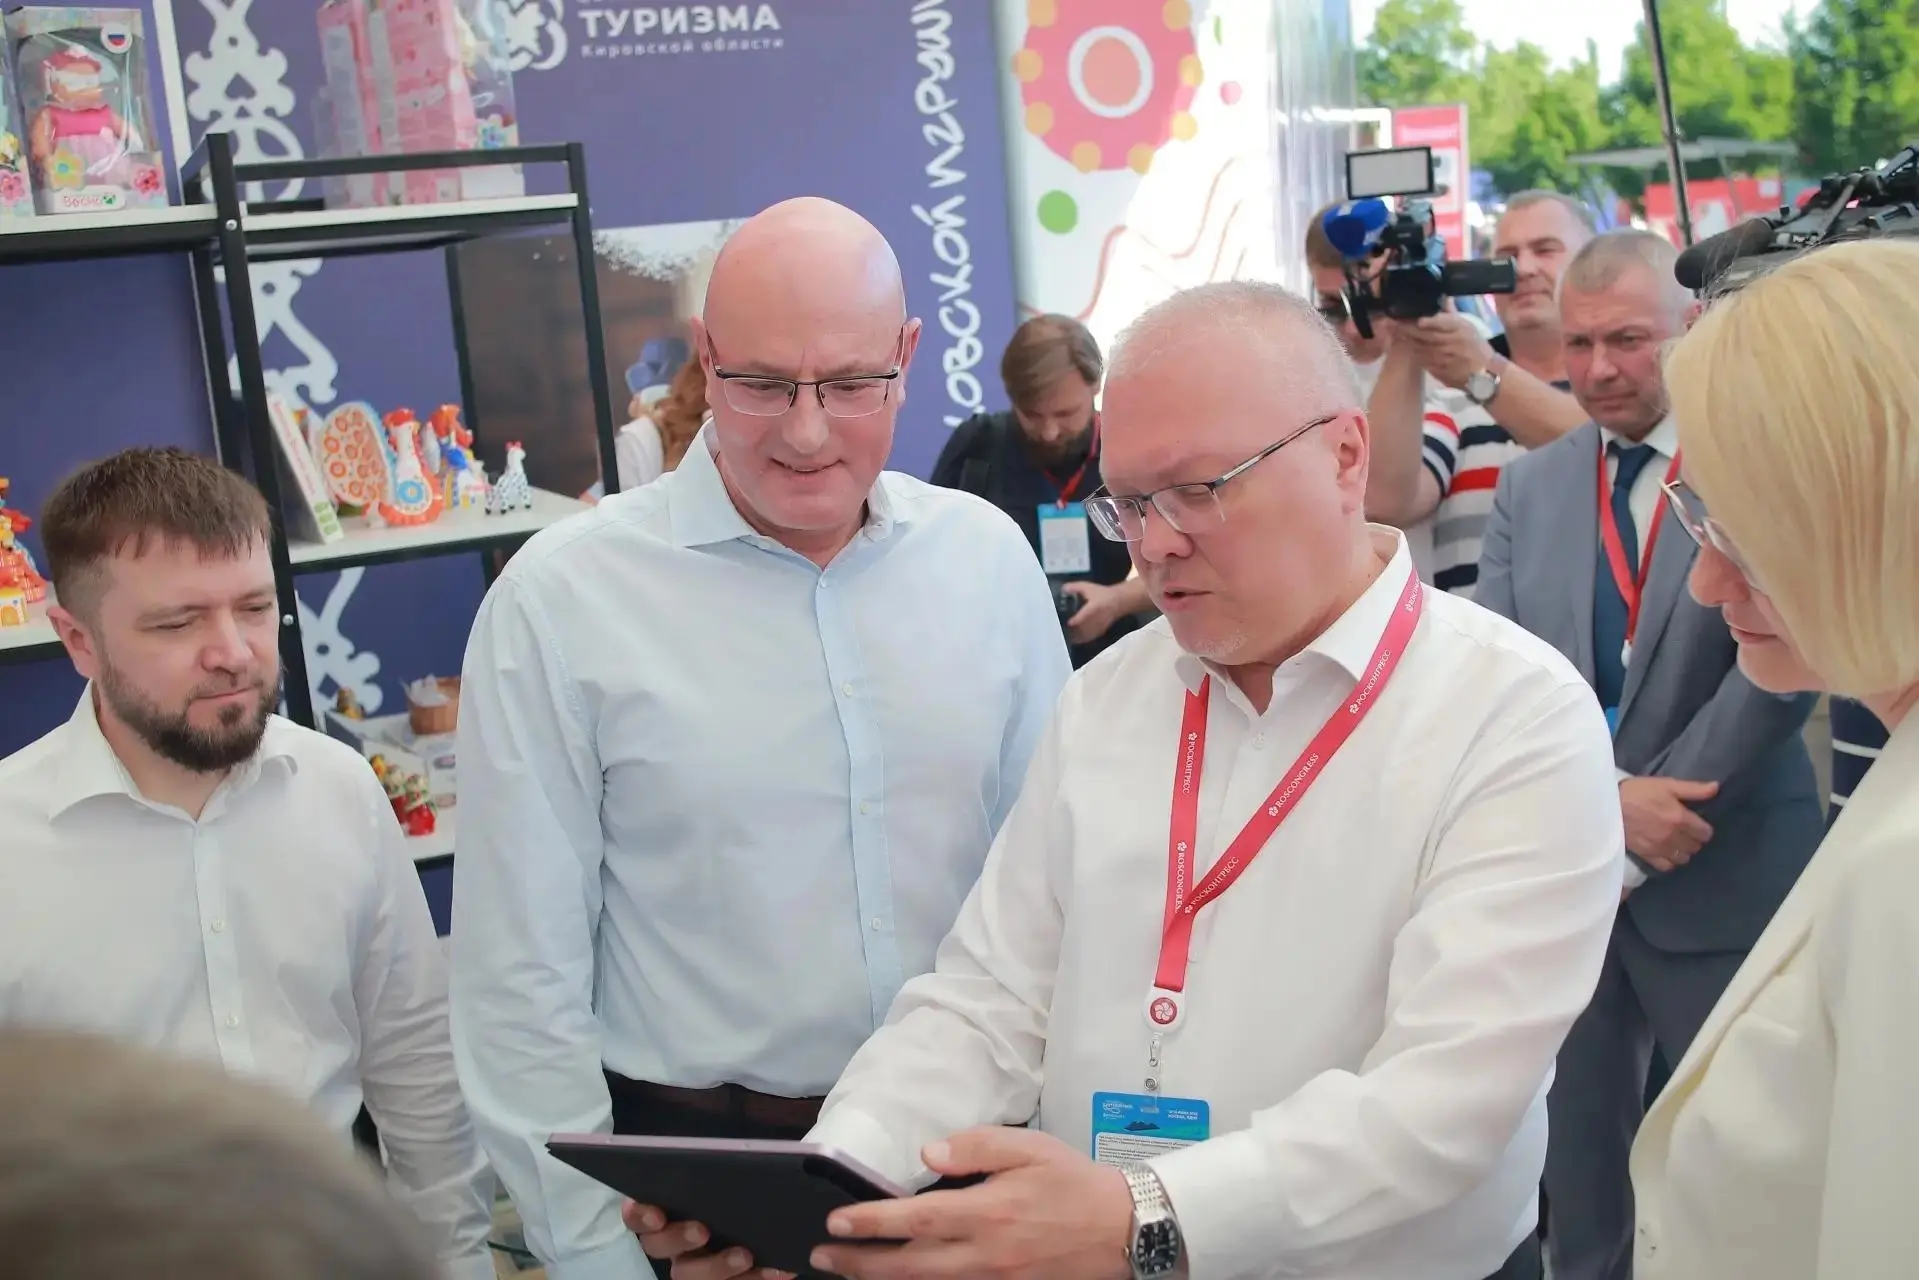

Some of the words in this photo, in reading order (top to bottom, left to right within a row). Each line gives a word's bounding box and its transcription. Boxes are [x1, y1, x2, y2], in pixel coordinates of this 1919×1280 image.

[578, 4, 782, 38] ТУРИЗМА
[581, 40, 693, 59] Кировской
[701, 38, 784, 51] области
[1356, 649, 1391, 706] РОСКОНГРЕСС
[1183, 741, 1196, 794] РОСКОНГРЕСС
[1275, 752, 1319, 808] ROSCONGRESS
